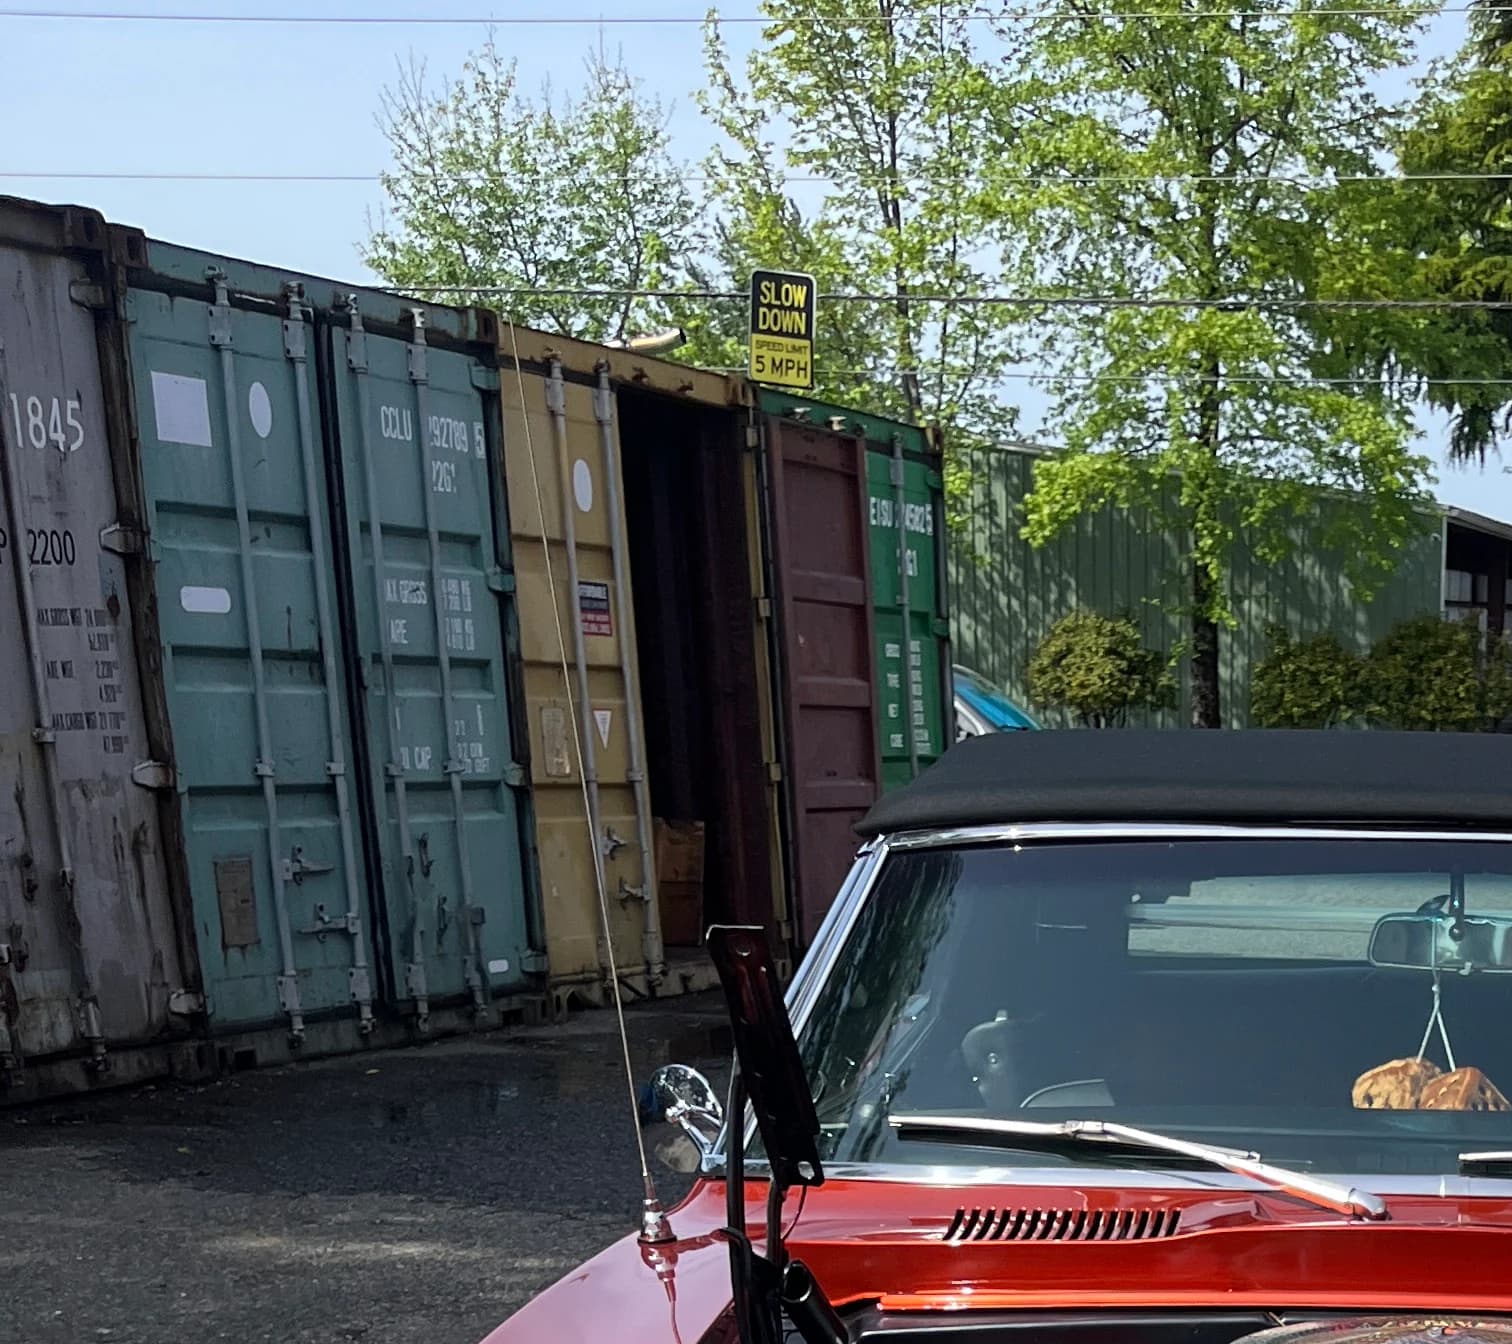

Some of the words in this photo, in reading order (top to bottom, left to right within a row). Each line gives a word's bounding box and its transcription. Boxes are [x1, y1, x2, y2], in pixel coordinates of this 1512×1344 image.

[760, 281, 807, 308] SLOW
[759, 307, 806, 335] DOWN
[755, 340, 784, 352] SPEED
[786, 344, 808, 355] LIMIT
[756, 355, 765, 373] 5
[771, 357, 807, 379] MPH
[10, 393, 84, 452] 1845
[380, 405, 412, 441] CCLU
[27, 528, 76, 566] 2200
